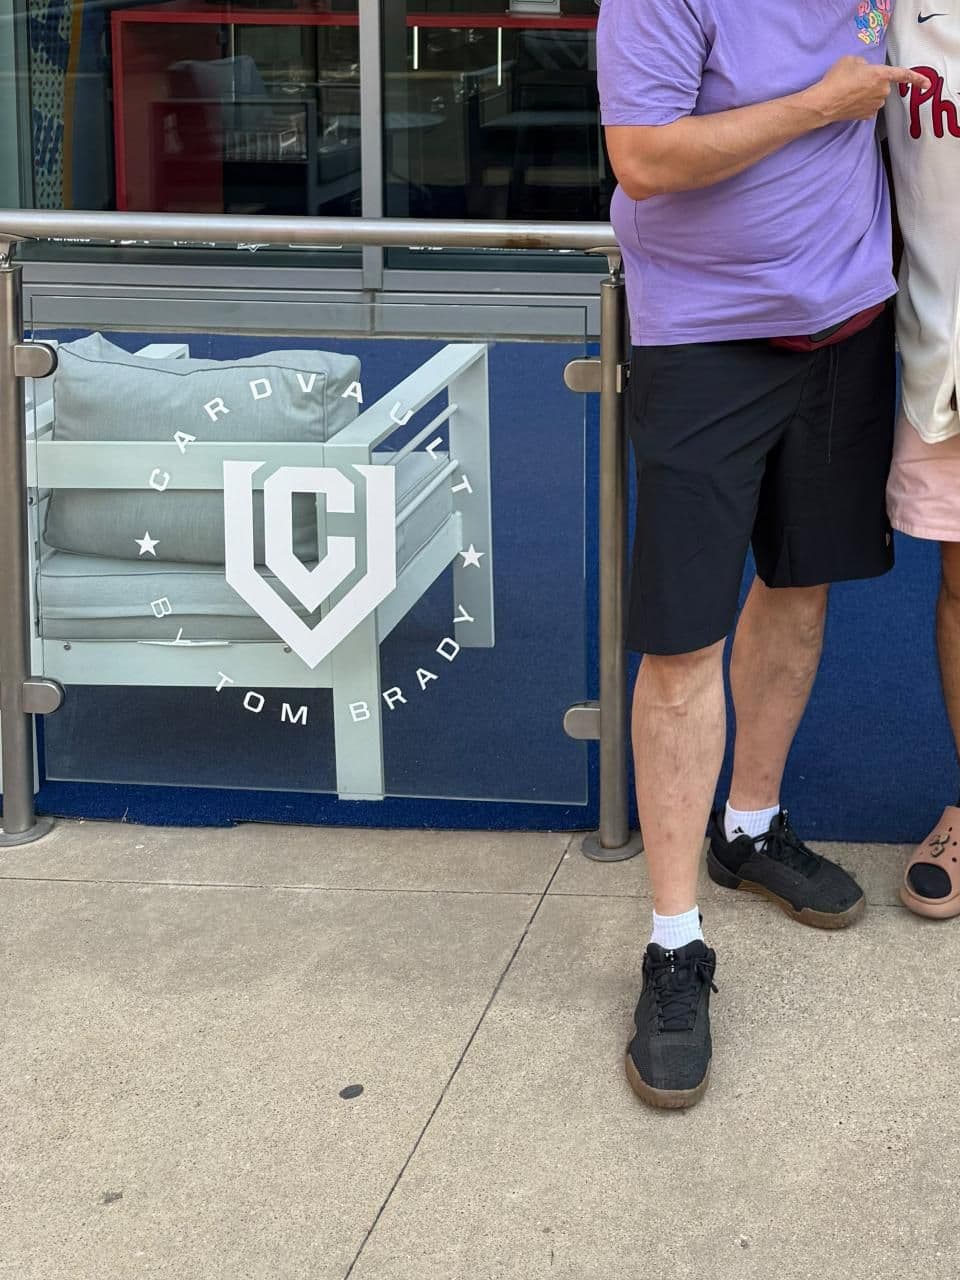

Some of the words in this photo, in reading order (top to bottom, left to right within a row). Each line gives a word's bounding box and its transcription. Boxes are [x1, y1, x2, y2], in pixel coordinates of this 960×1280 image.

[149, 373, 473, 497] CARDVAULT
[214, 671, 309, 726] TOM
[350, 604, 475, 723] BRADY
